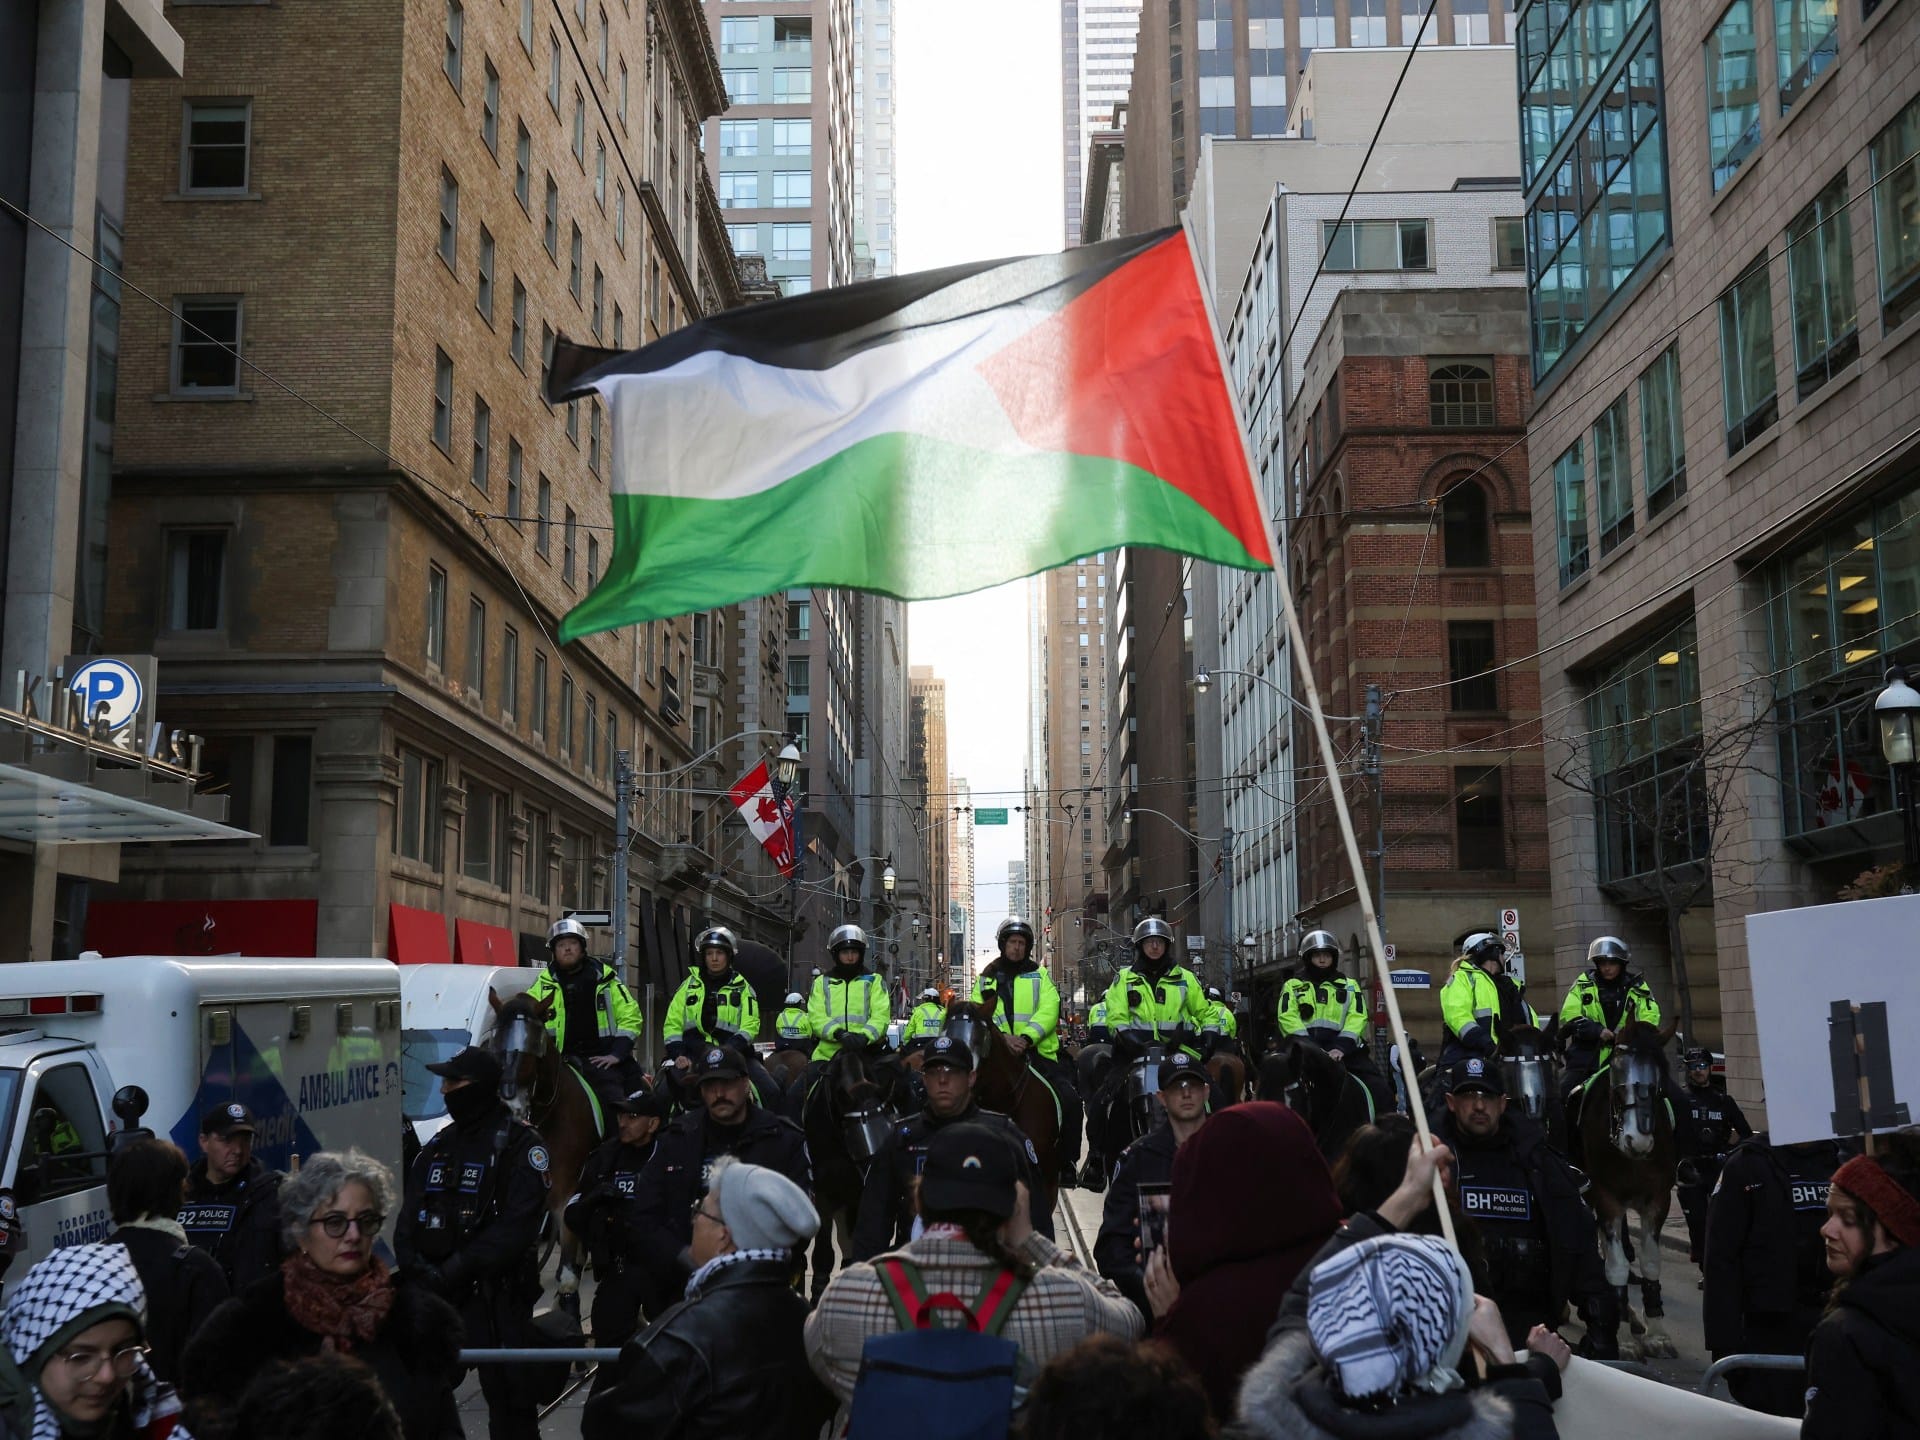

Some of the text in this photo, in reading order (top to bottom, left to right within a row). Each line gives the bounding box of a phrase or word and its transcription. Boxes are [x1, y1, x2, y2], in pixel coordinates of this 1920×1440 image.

[88, 671, 125, 720] P
[1393, 975, 1415, 983] Toronto
[299, 1064, 379, 1113] AMBULANCE
[1466, 1192, 1525, 1209] BH POLICE
[1792, 1186, 1818, 1203] BH
[58, 1209, 105, 1231] TORONTO
[176, 1209, 230, 1225] B2 POLICE
